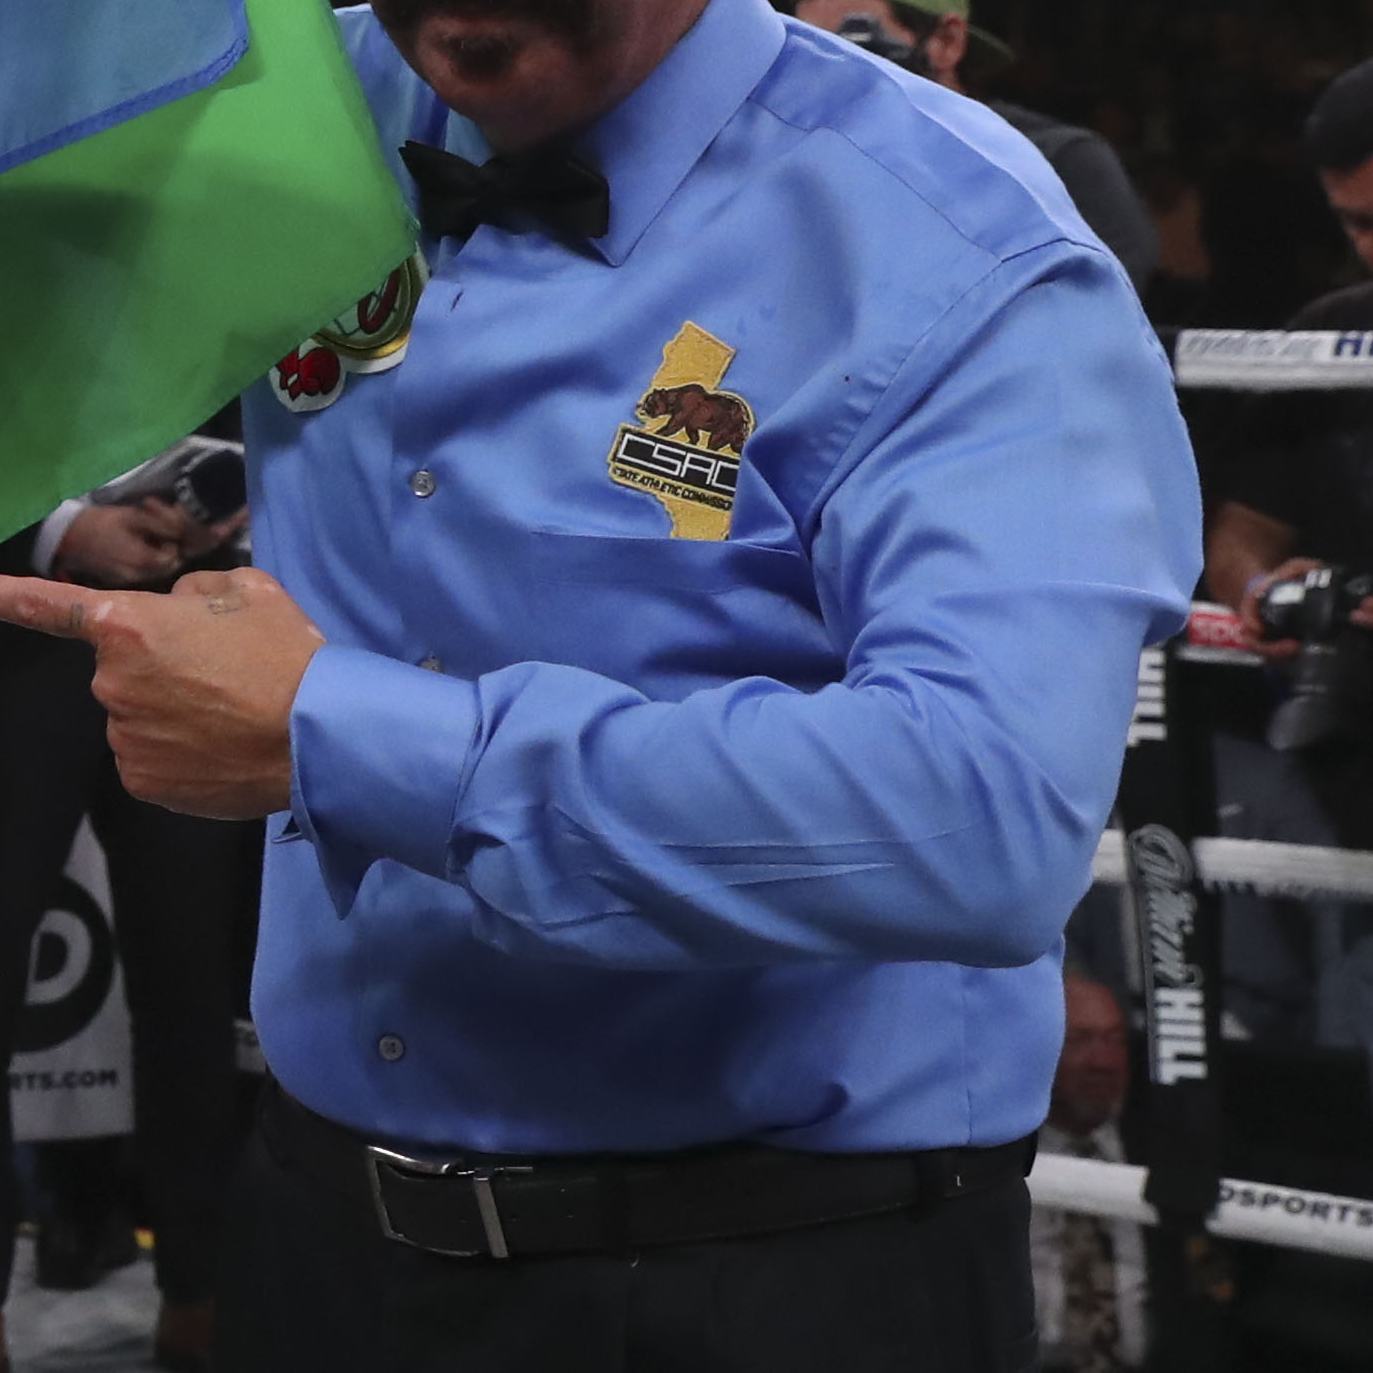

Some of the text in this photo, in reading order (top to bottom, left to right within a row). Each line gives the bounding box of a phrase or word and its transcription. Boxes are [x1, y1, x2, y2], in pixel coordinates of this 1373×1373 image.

[616, 433, 740, 493] CSAC
[681, 488, 733, 511] COMMISSIO
[1155, 987, 1209, 1086] HILL
